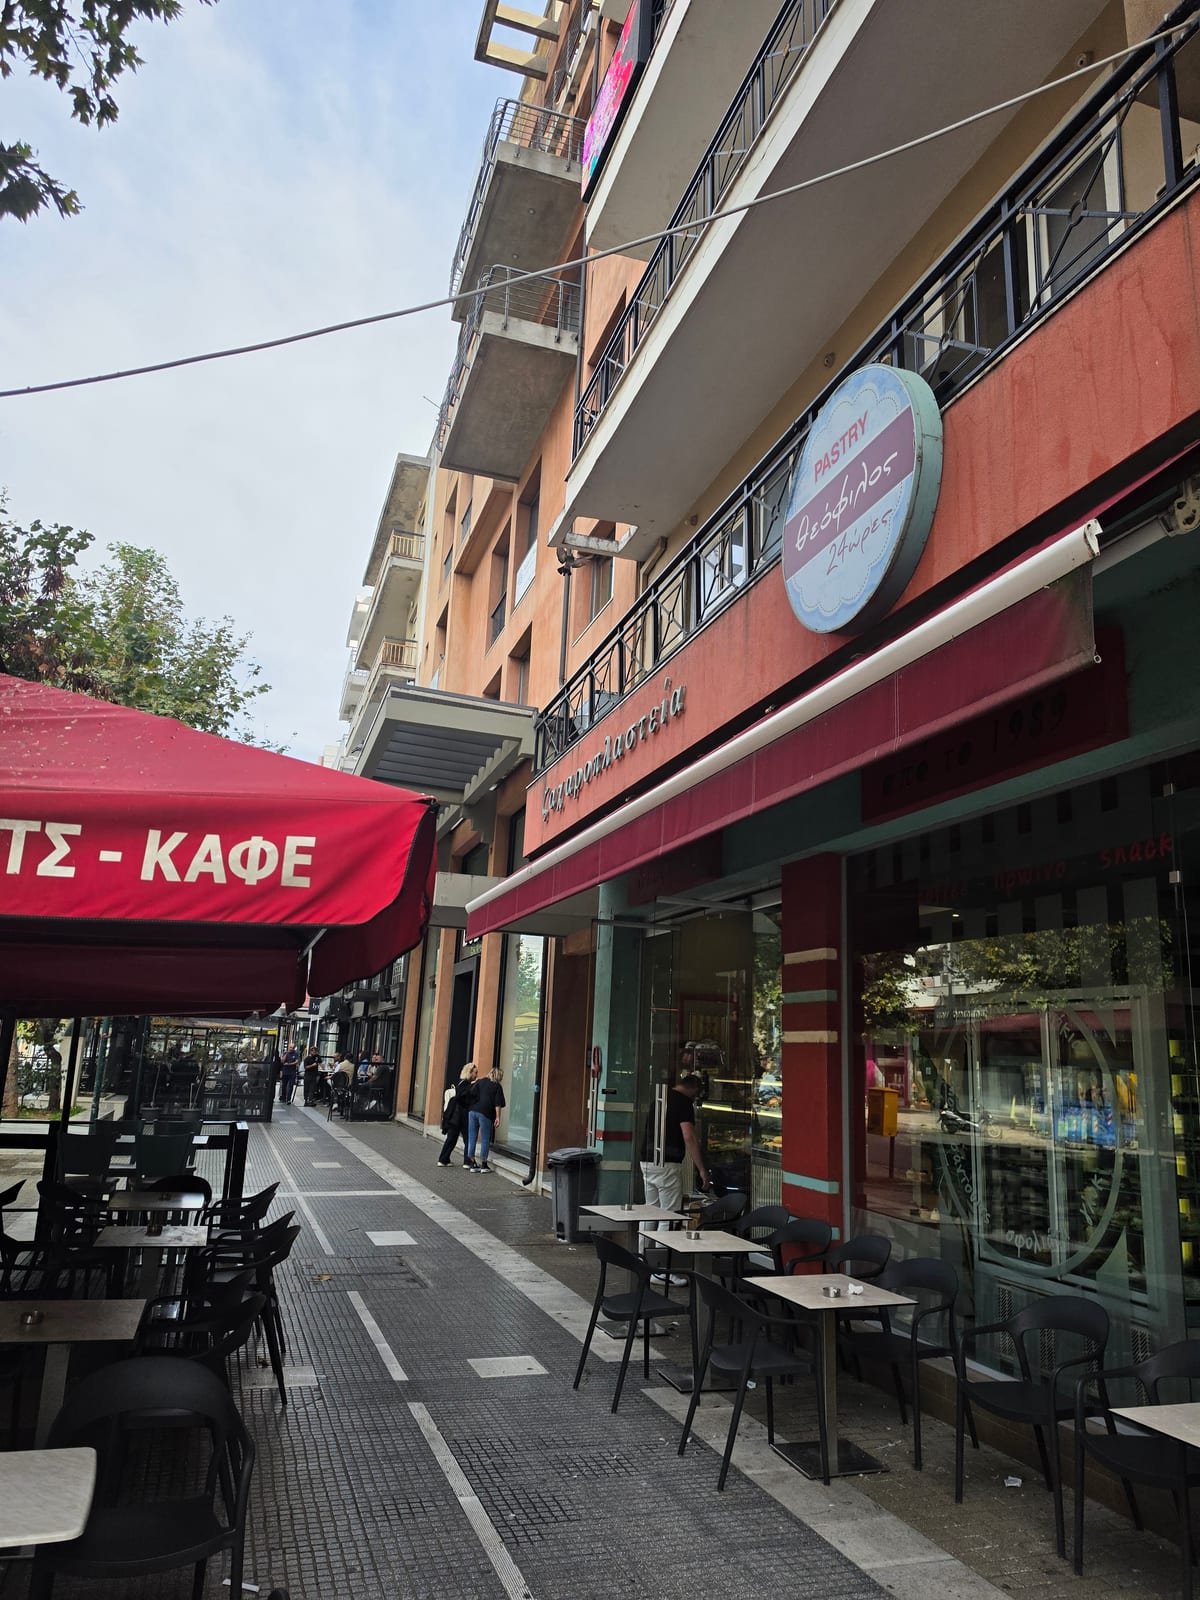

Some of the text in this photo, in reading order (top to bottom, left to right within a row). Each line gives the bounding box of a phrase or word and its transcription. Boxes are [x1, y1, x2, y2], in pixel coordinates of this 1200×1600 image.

[813, 410, 869, 482] PASTRY
[541, 676, 687, 823] ζαχαροπλαστεία
[140, 829, 317, 888] ΚΑΦΕ
[1100, 832, 1173, 869] snack
